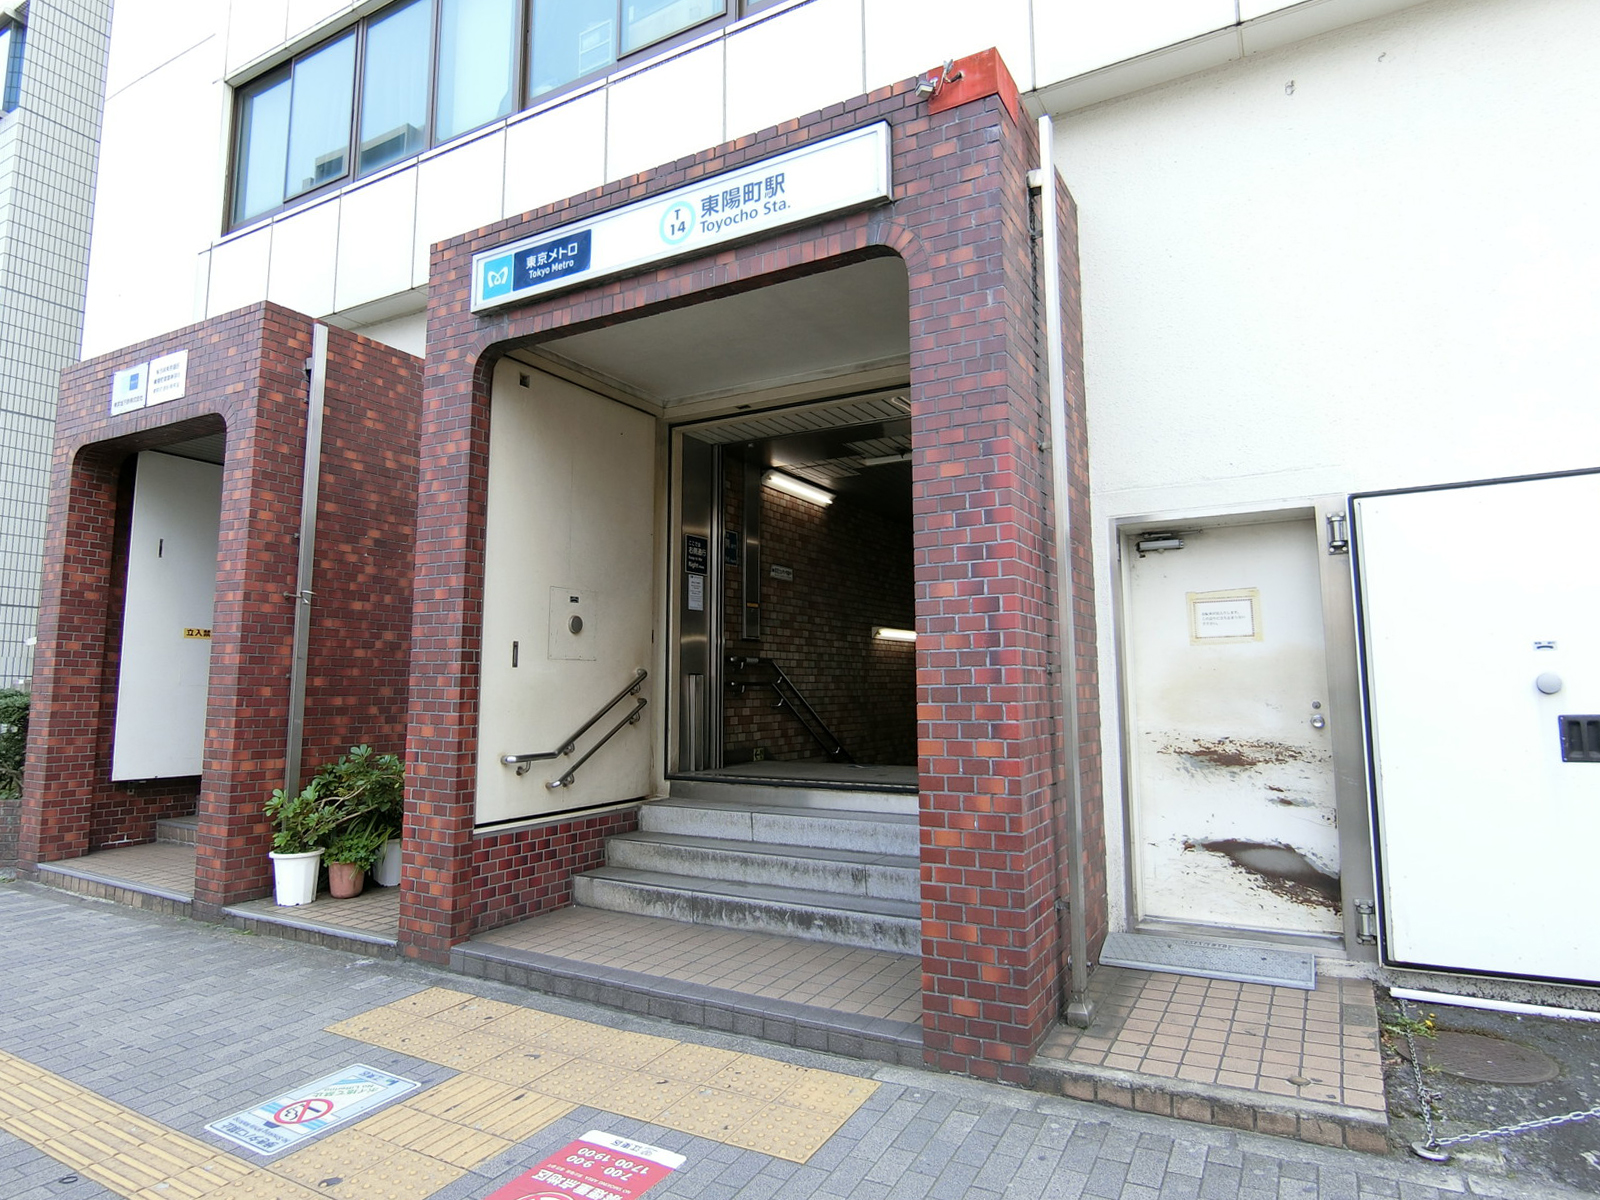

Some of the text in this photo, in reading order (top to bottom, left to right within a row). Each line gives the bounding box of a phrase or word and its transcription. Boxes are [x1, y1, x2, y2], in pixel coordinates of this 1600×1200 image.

[701, 172, 785, 218] 東陽町駅
[674, 209, 681, 220] T
[700, 200, 791, 233] Toyocho Sta.
[670, 221, 686, 236] 14
[526, 242, 578, 269] 東京メトロ
[528, 259, 574, 279] Tokyo Metro
